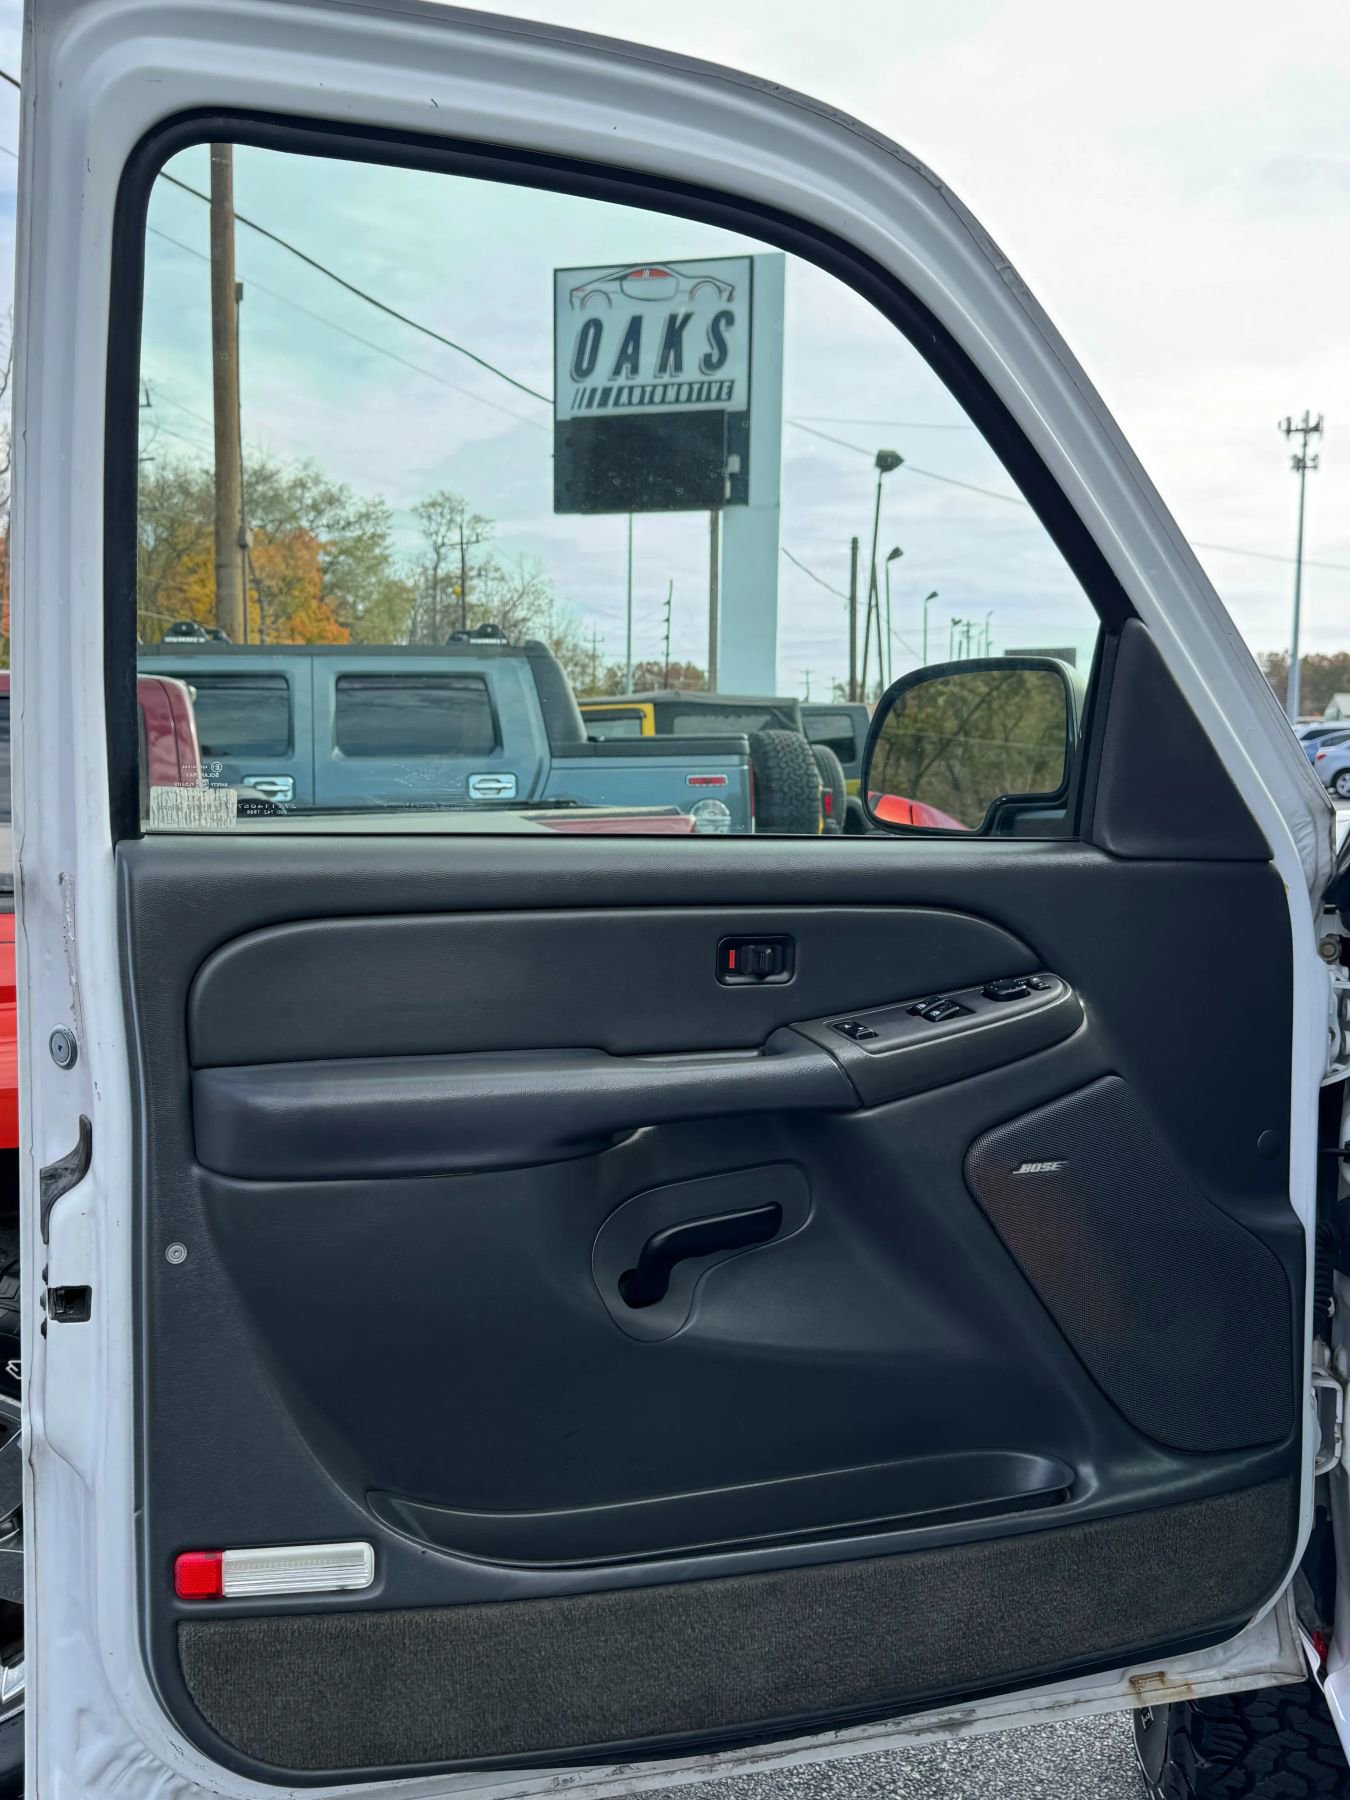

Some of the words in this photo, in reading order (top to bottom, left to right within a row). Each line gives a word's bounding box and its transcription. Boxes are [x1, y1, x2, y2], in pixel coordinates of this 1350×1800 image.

[571, 310, 735, 382] OAKS
[618, 381, 734, 406] AUTOMOTIVE
[1012, 1161, 1067, 1174] BOSE
